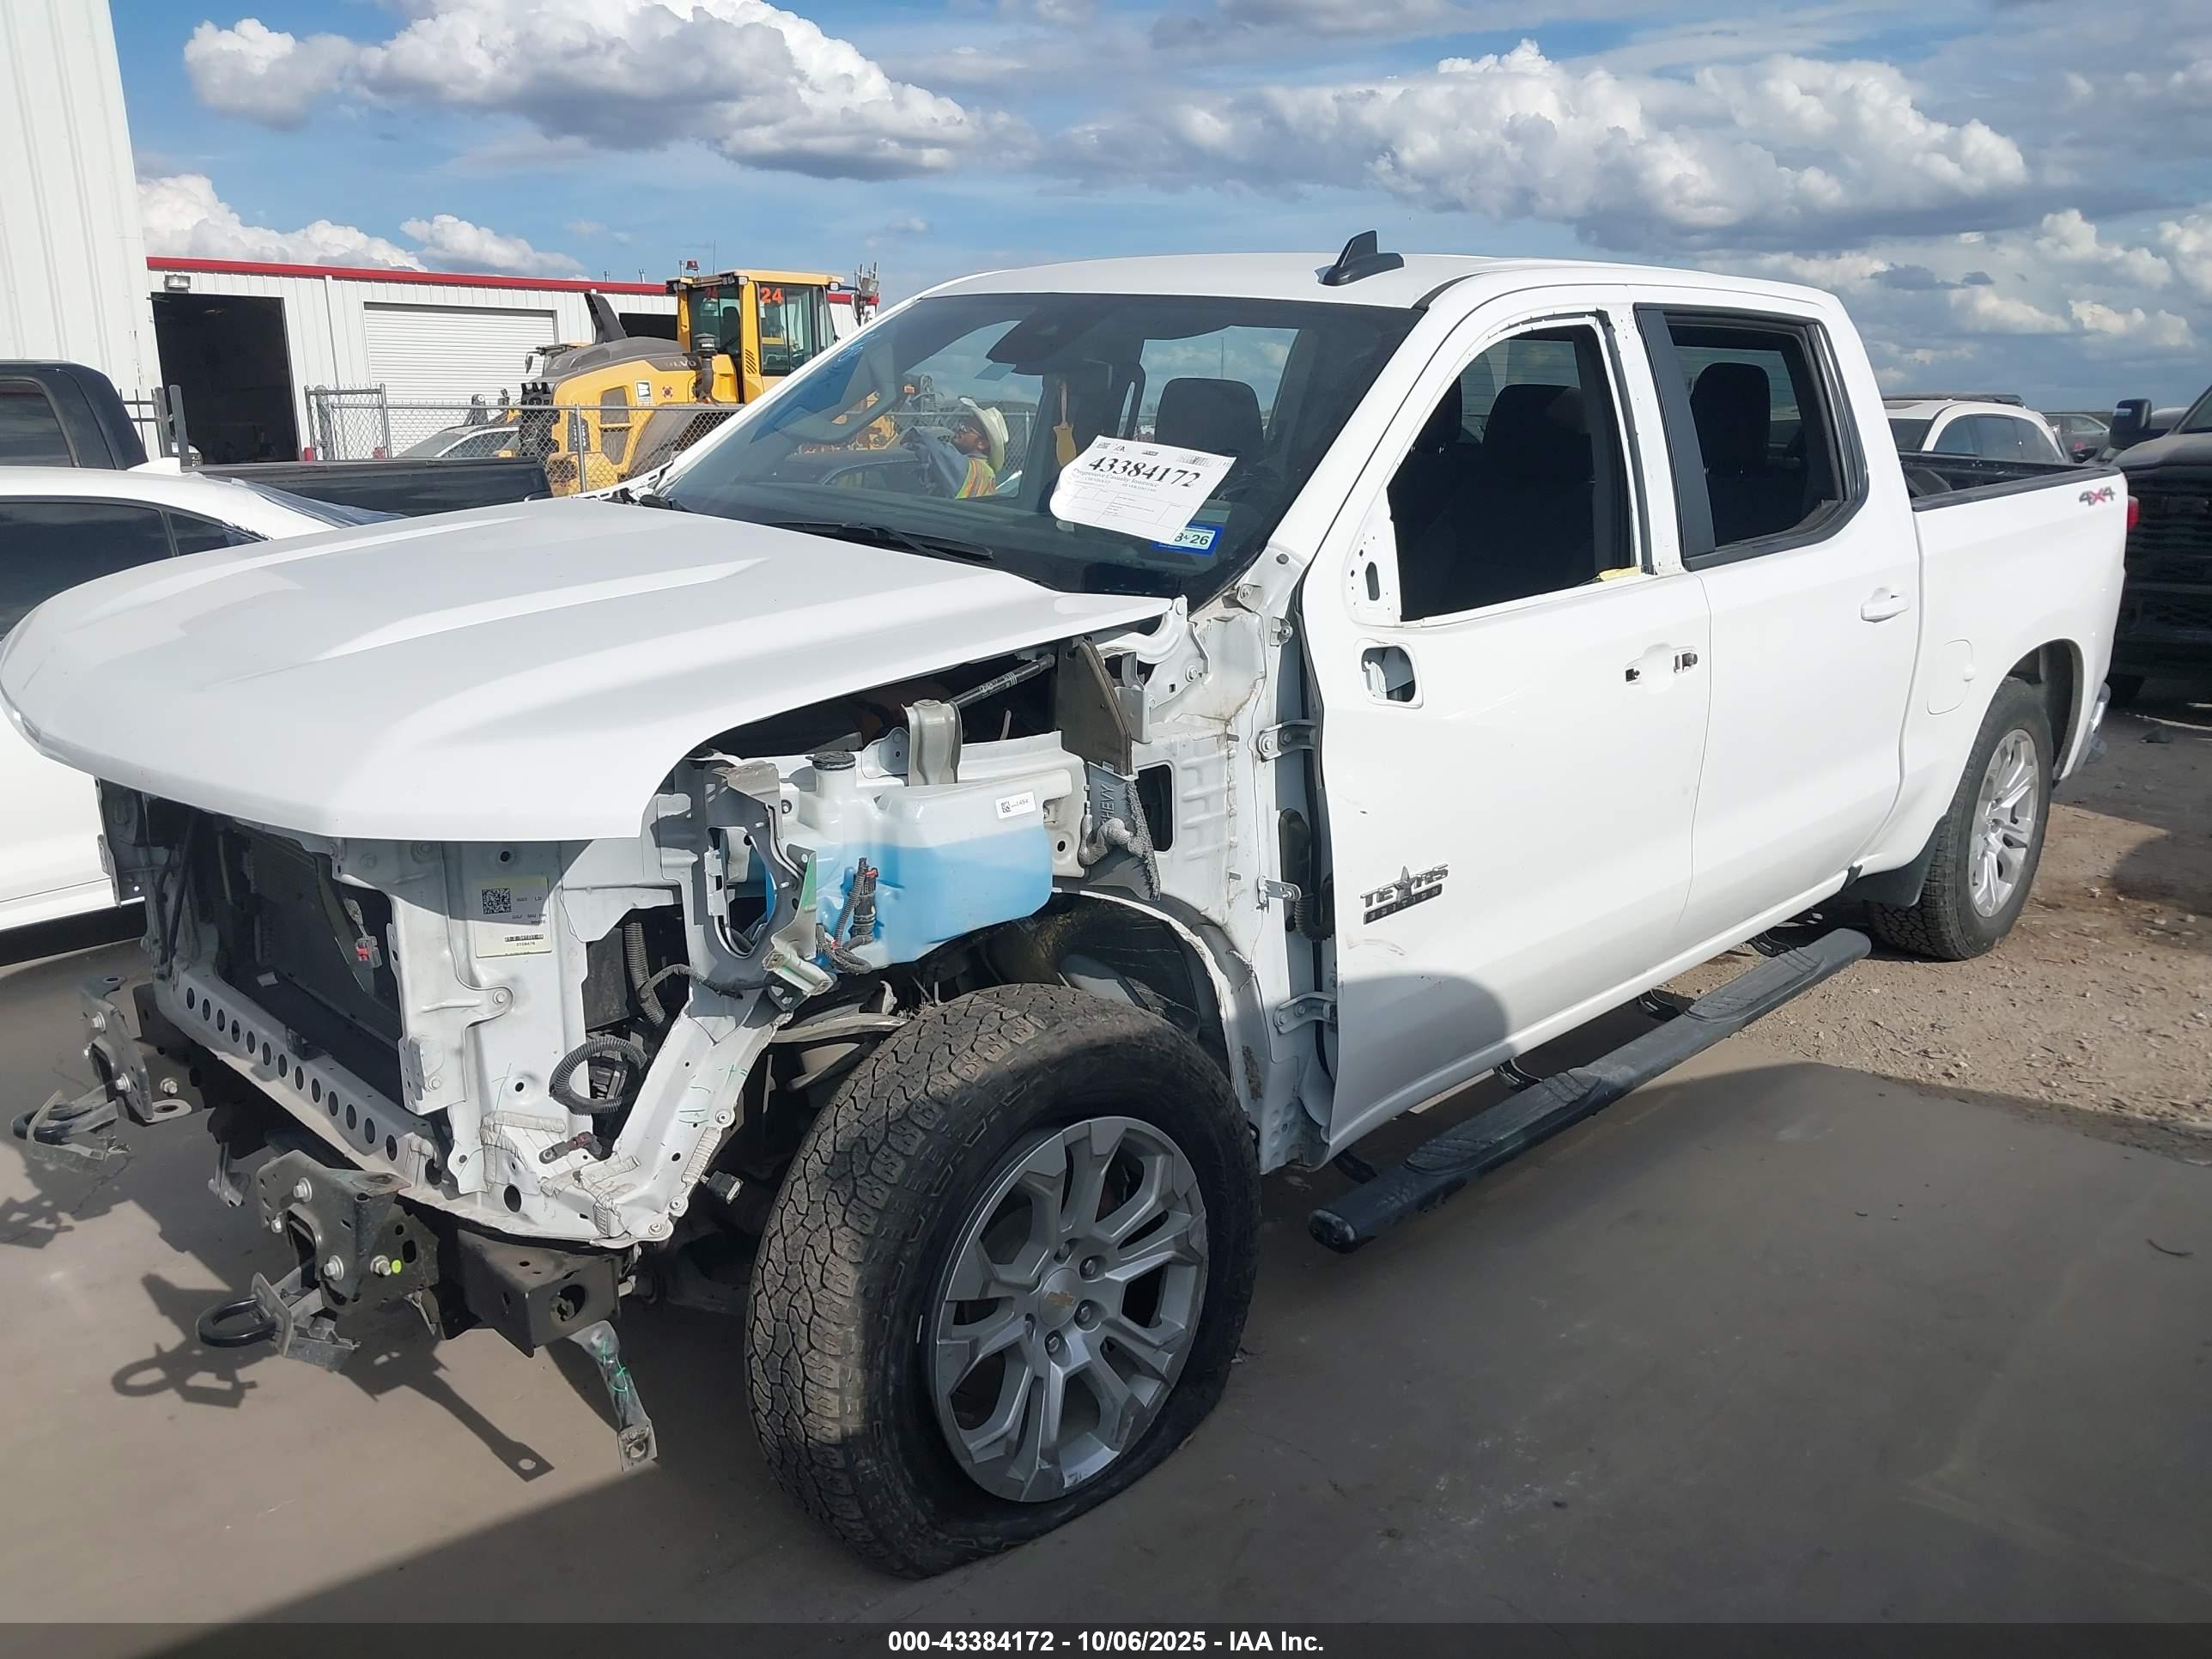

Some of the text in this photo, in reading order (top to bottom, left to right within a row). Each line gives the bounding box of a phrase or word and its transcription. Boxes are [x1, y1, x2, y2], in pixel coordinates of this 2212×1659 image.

[760, 287, 783, 303] 24
[1088, 456, 1201, 487] 43384172
[1189, 534, 1210, 545] 26
